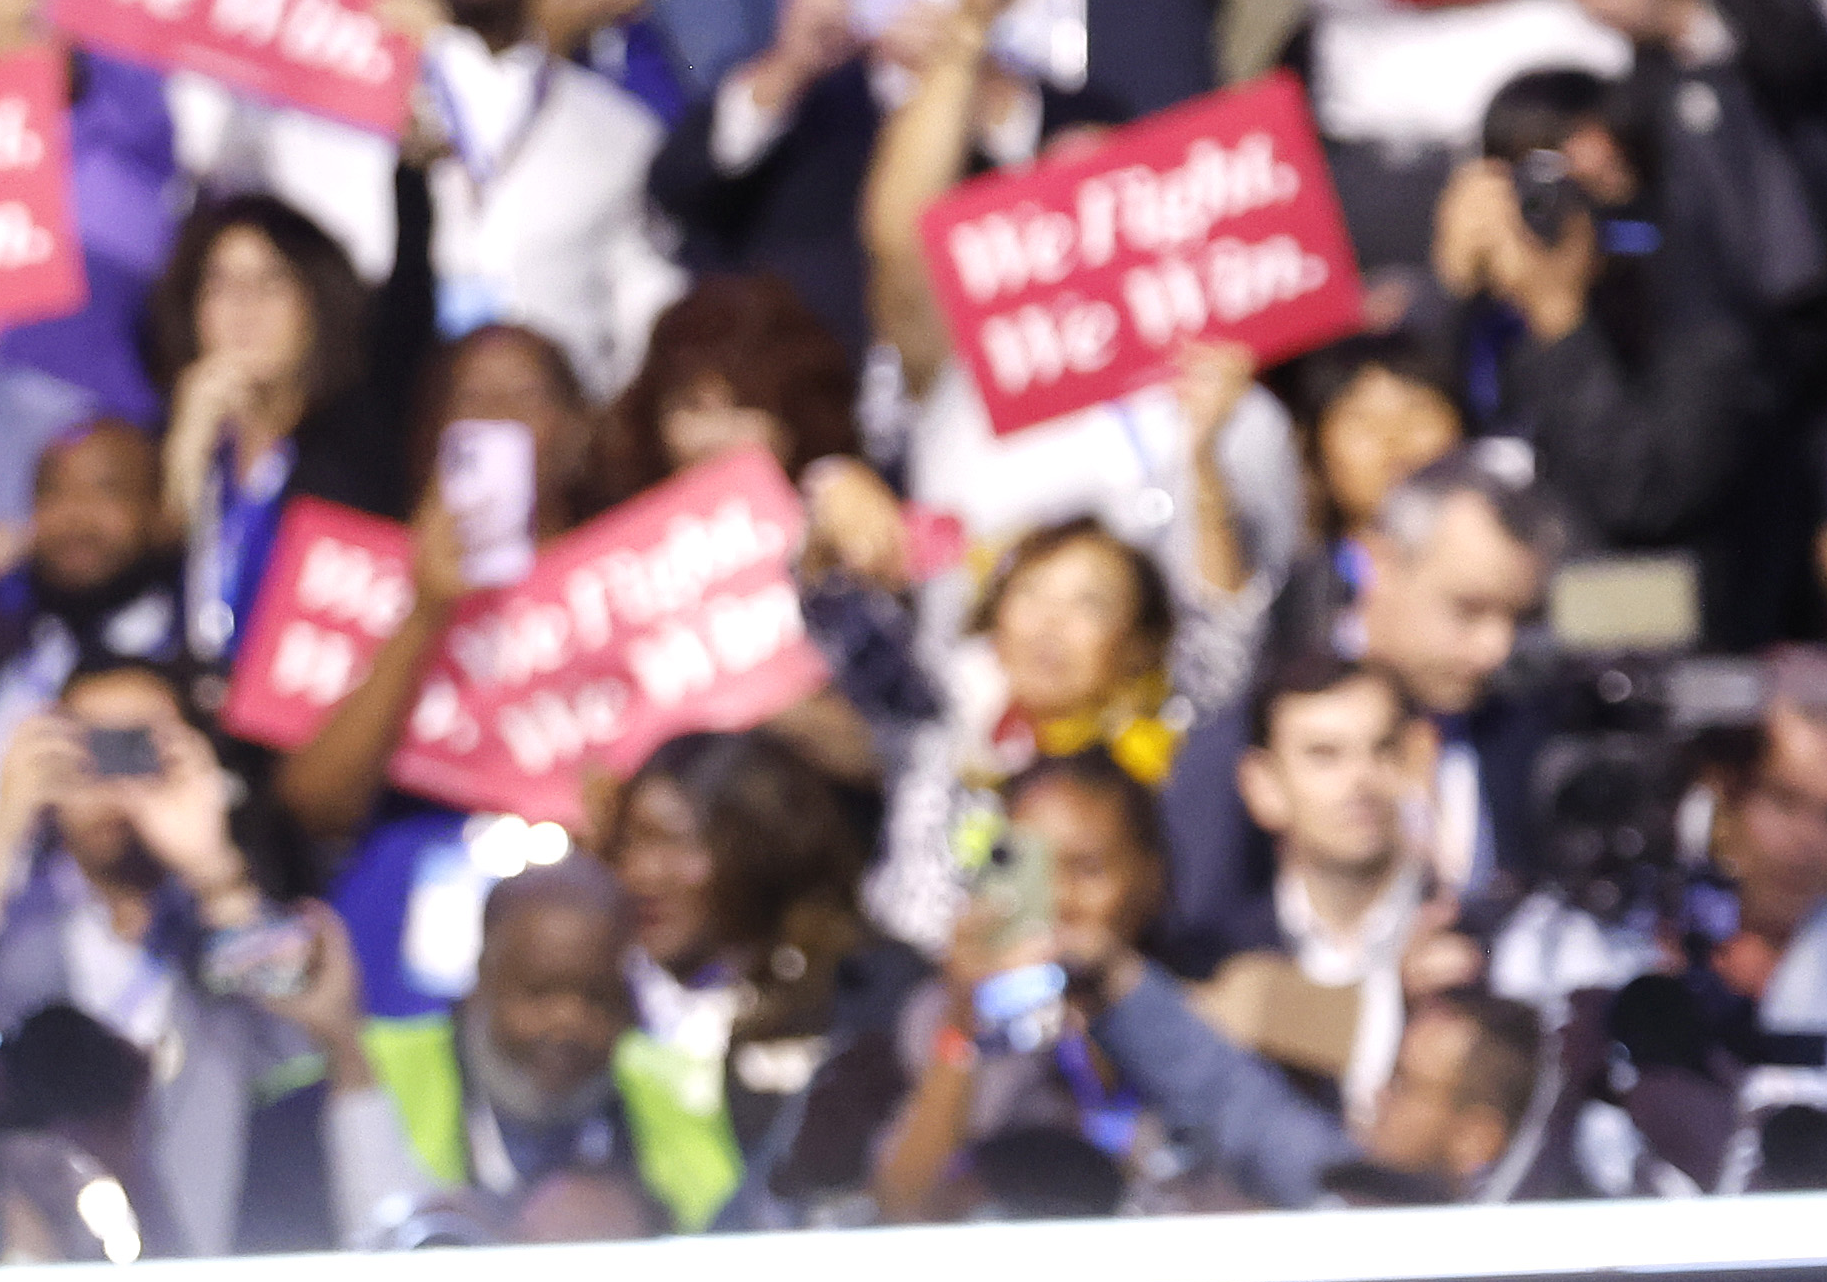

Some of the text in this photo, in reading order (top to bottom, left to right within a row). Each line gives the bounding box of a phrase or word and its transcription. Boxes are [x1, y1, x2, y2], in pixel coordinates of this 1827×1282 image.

[946, 129, 1301, 305] We Fight.
[973, 231, 1332, 400] We Win.
[297, 534, 416, 639] We
[564, 497, 788, 651] Fight.
[494, 674, 633, 776] We
